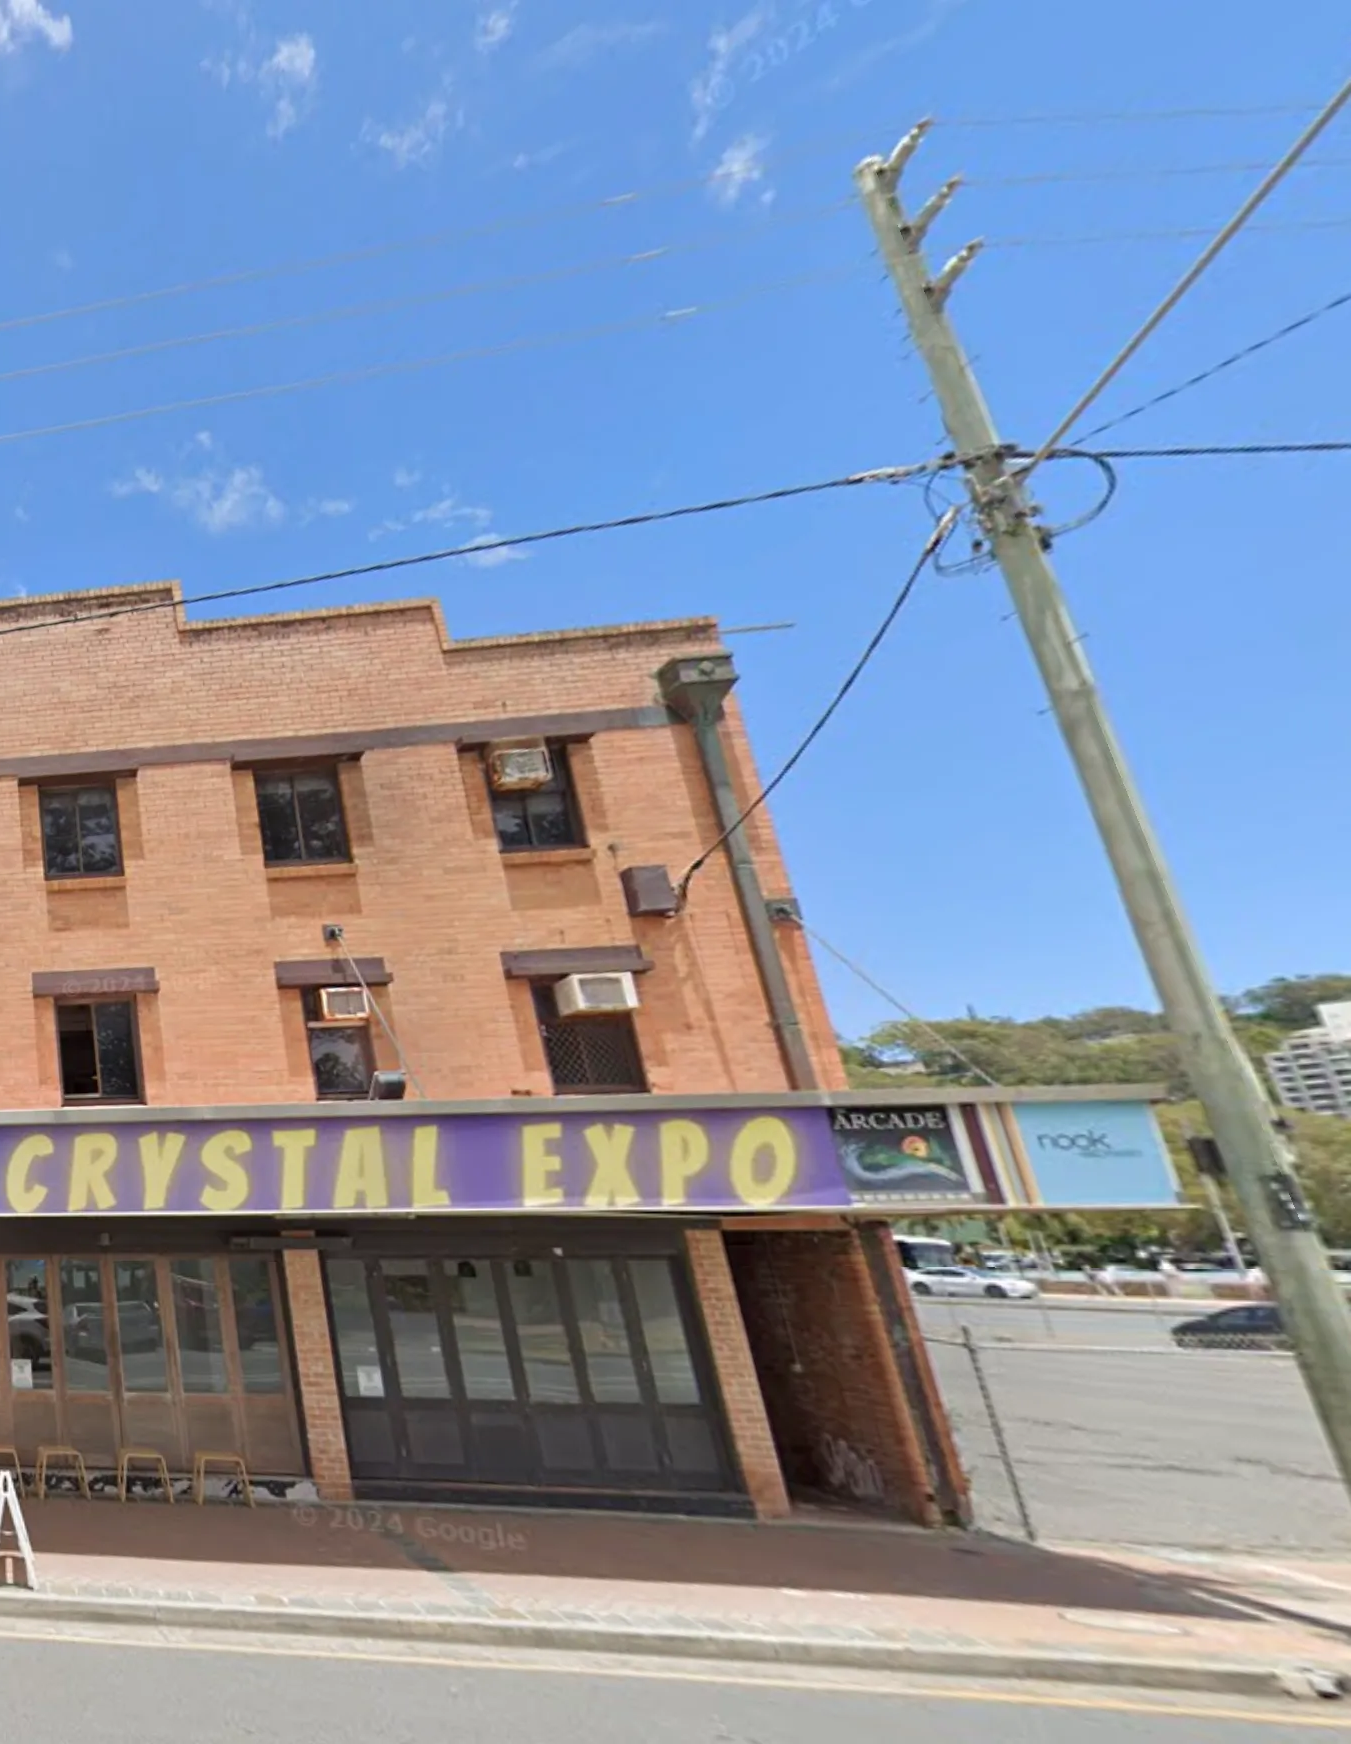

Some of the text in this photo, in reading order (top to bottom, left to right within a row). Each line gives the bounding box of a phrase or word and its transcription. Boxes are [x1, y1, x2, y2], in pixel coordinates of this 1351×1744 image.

[833, 1111, 947, 1131] ARCADE
[1037, 1129, 1111, 1152] nook
[5, 1115, 796, 1214] CRYSTAL EXPO
